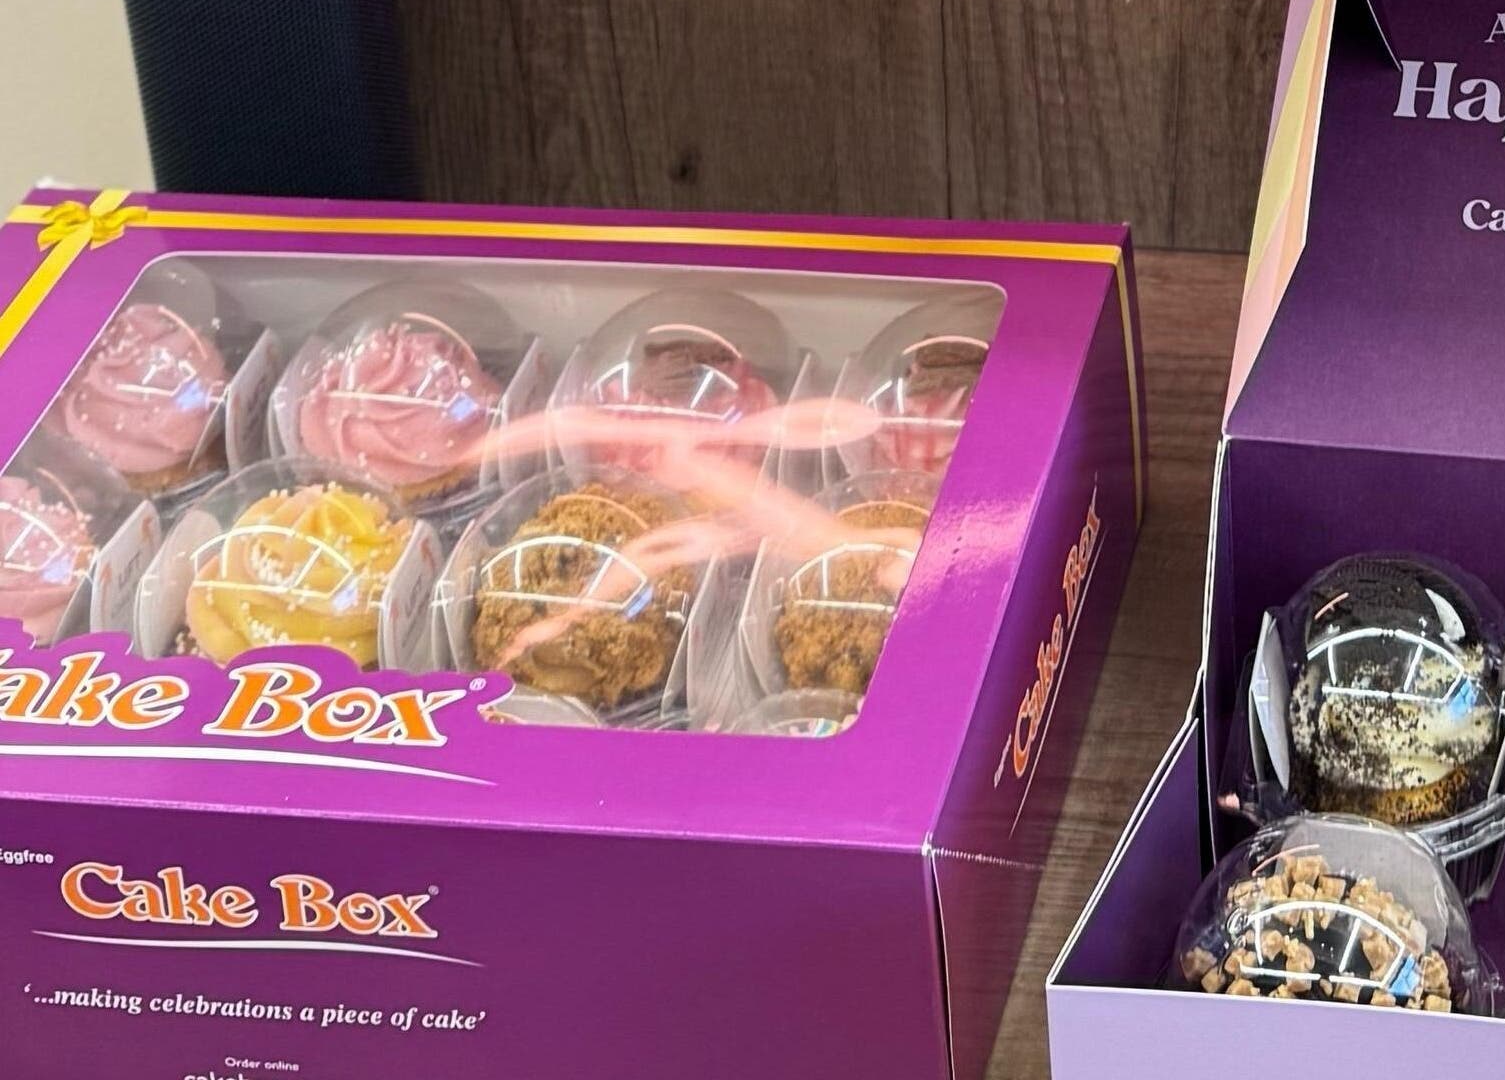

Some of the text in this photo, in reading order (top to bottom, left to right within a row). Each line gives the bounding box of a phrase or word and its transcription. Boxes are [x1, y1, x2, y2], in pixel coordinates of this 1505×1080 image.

[1013, 471, 1101, 778] Cake Box
[0, 645, 190, 730] ake
[60, 861, 258, 929] Cake
[149, 993, 293, 1021] celebrations
[299, 1007, 315, 1021] a
[321, 1004, 383, 1027] piece
[390, 1007, 418, 1031] of
[224, 1056, 300, 1072] Order online
